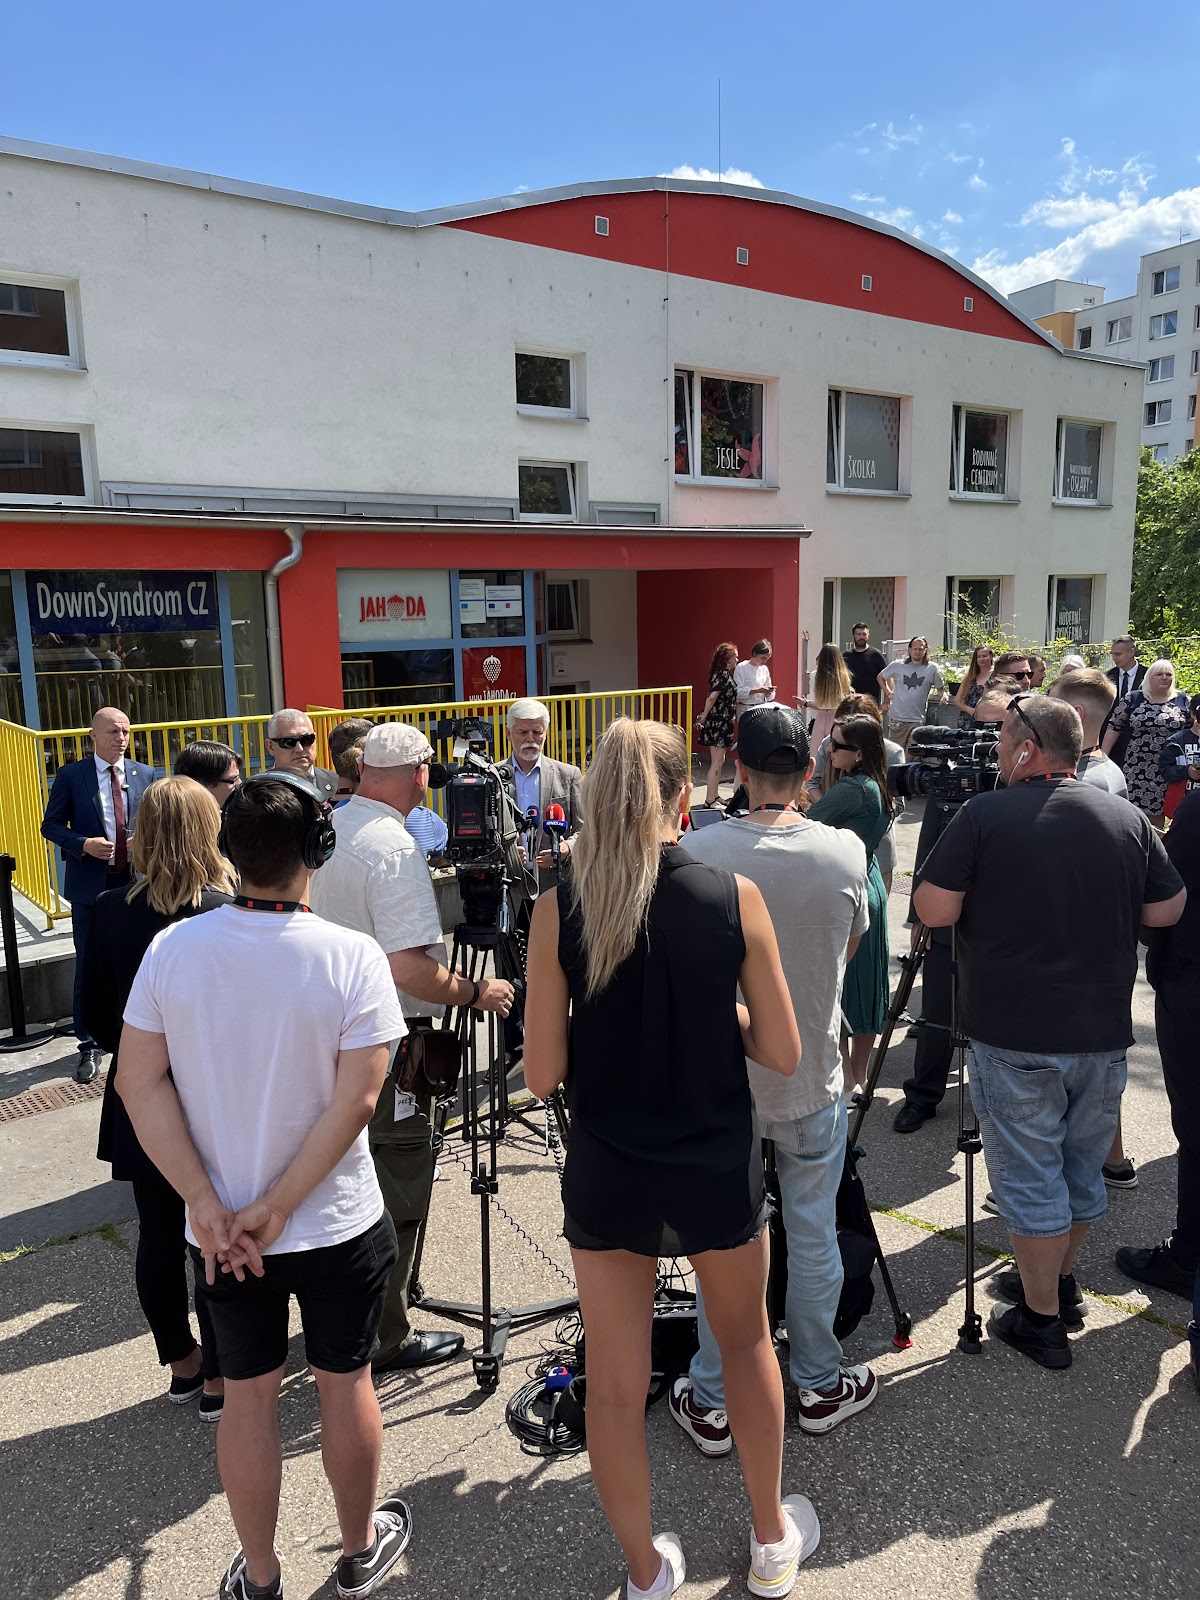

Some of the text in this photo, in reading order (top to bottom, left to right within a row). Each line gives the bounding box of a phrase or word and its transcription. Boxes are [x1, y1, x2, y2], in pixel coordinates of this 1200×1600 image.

[716, 447, 740, 470] JESLE
[848, 455, 876, 479] ŠKOLKA
[972, 448, 998, 467] RODINNÉ
[971, 469, 998, 485] CENTRUM
[1070, 475, 1090, 492] OSLAVY
[36, 581, 209, 627] DownSyndrom CZ
